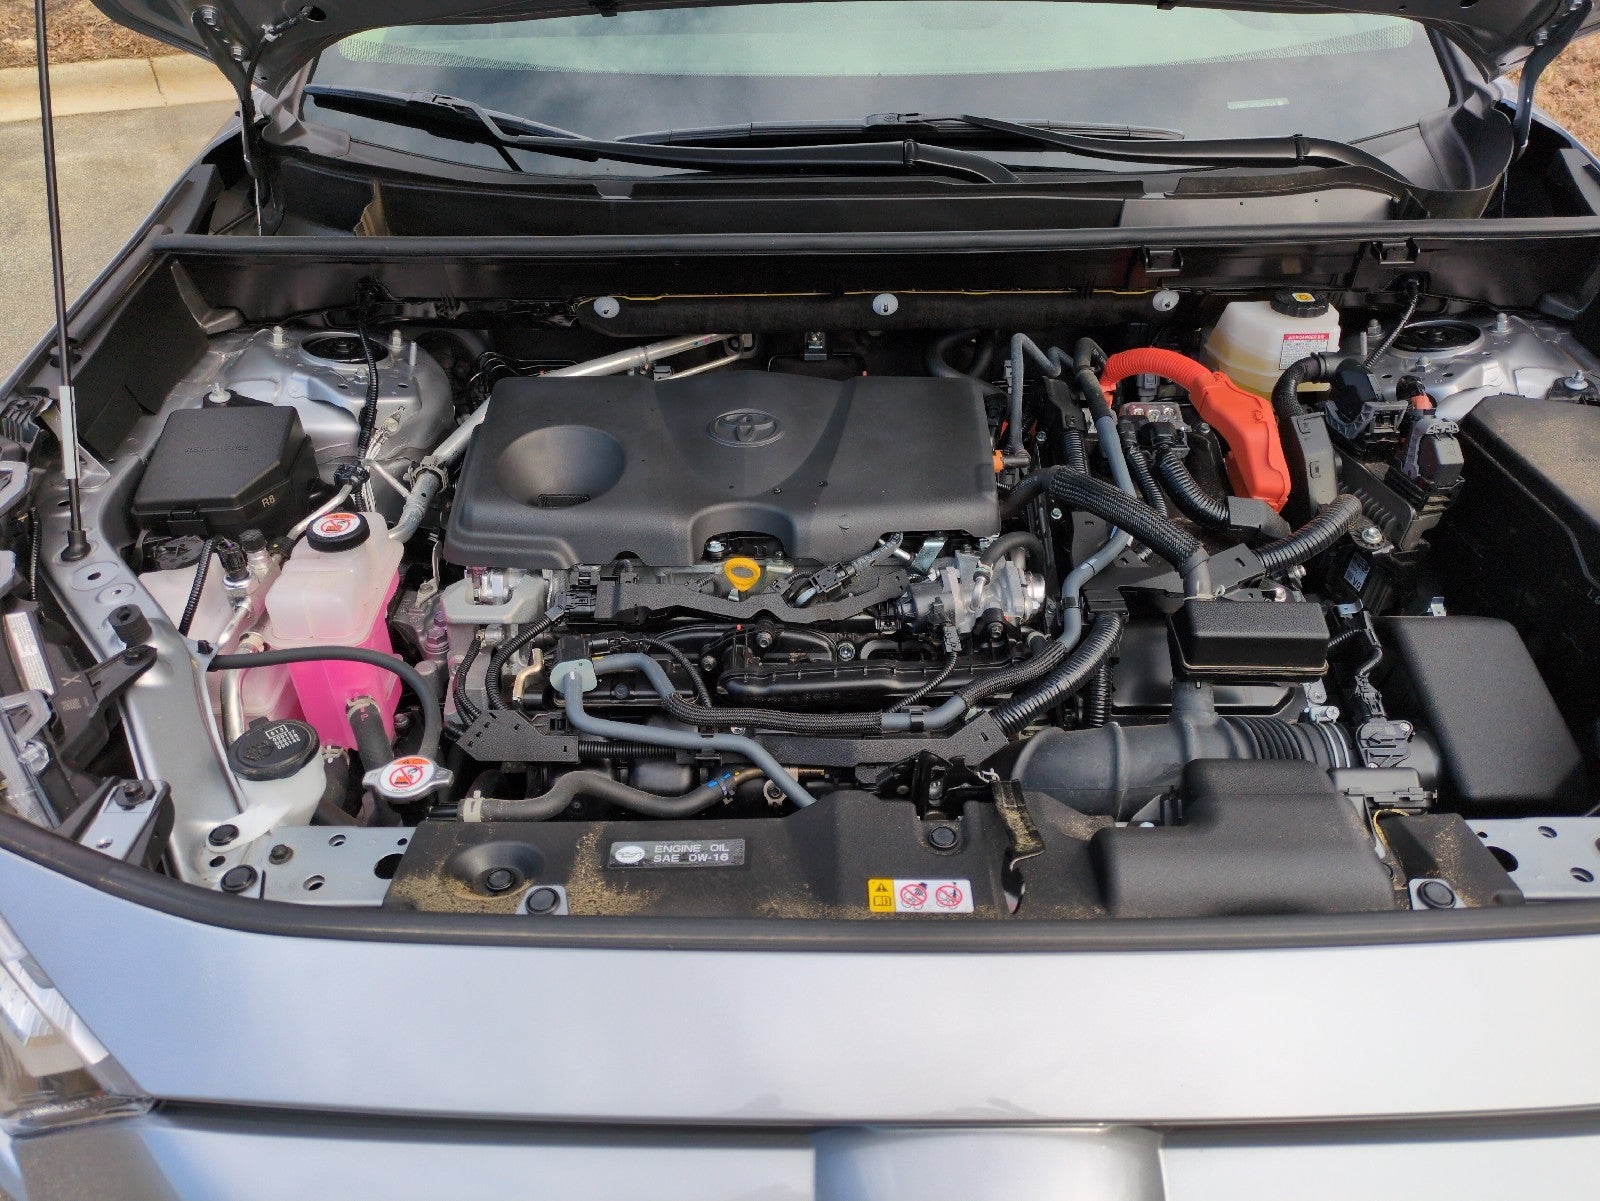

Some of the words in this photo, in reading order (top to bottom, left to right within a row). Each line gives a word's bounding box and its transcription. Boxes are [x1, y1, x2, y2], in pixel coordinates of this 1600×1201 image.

[261, 495, 275, 507] R8
[654, 844, 702, 854] ENGINE
[710, 843, 730, 852] OIL
[653, 854, 680, 863] SAE
